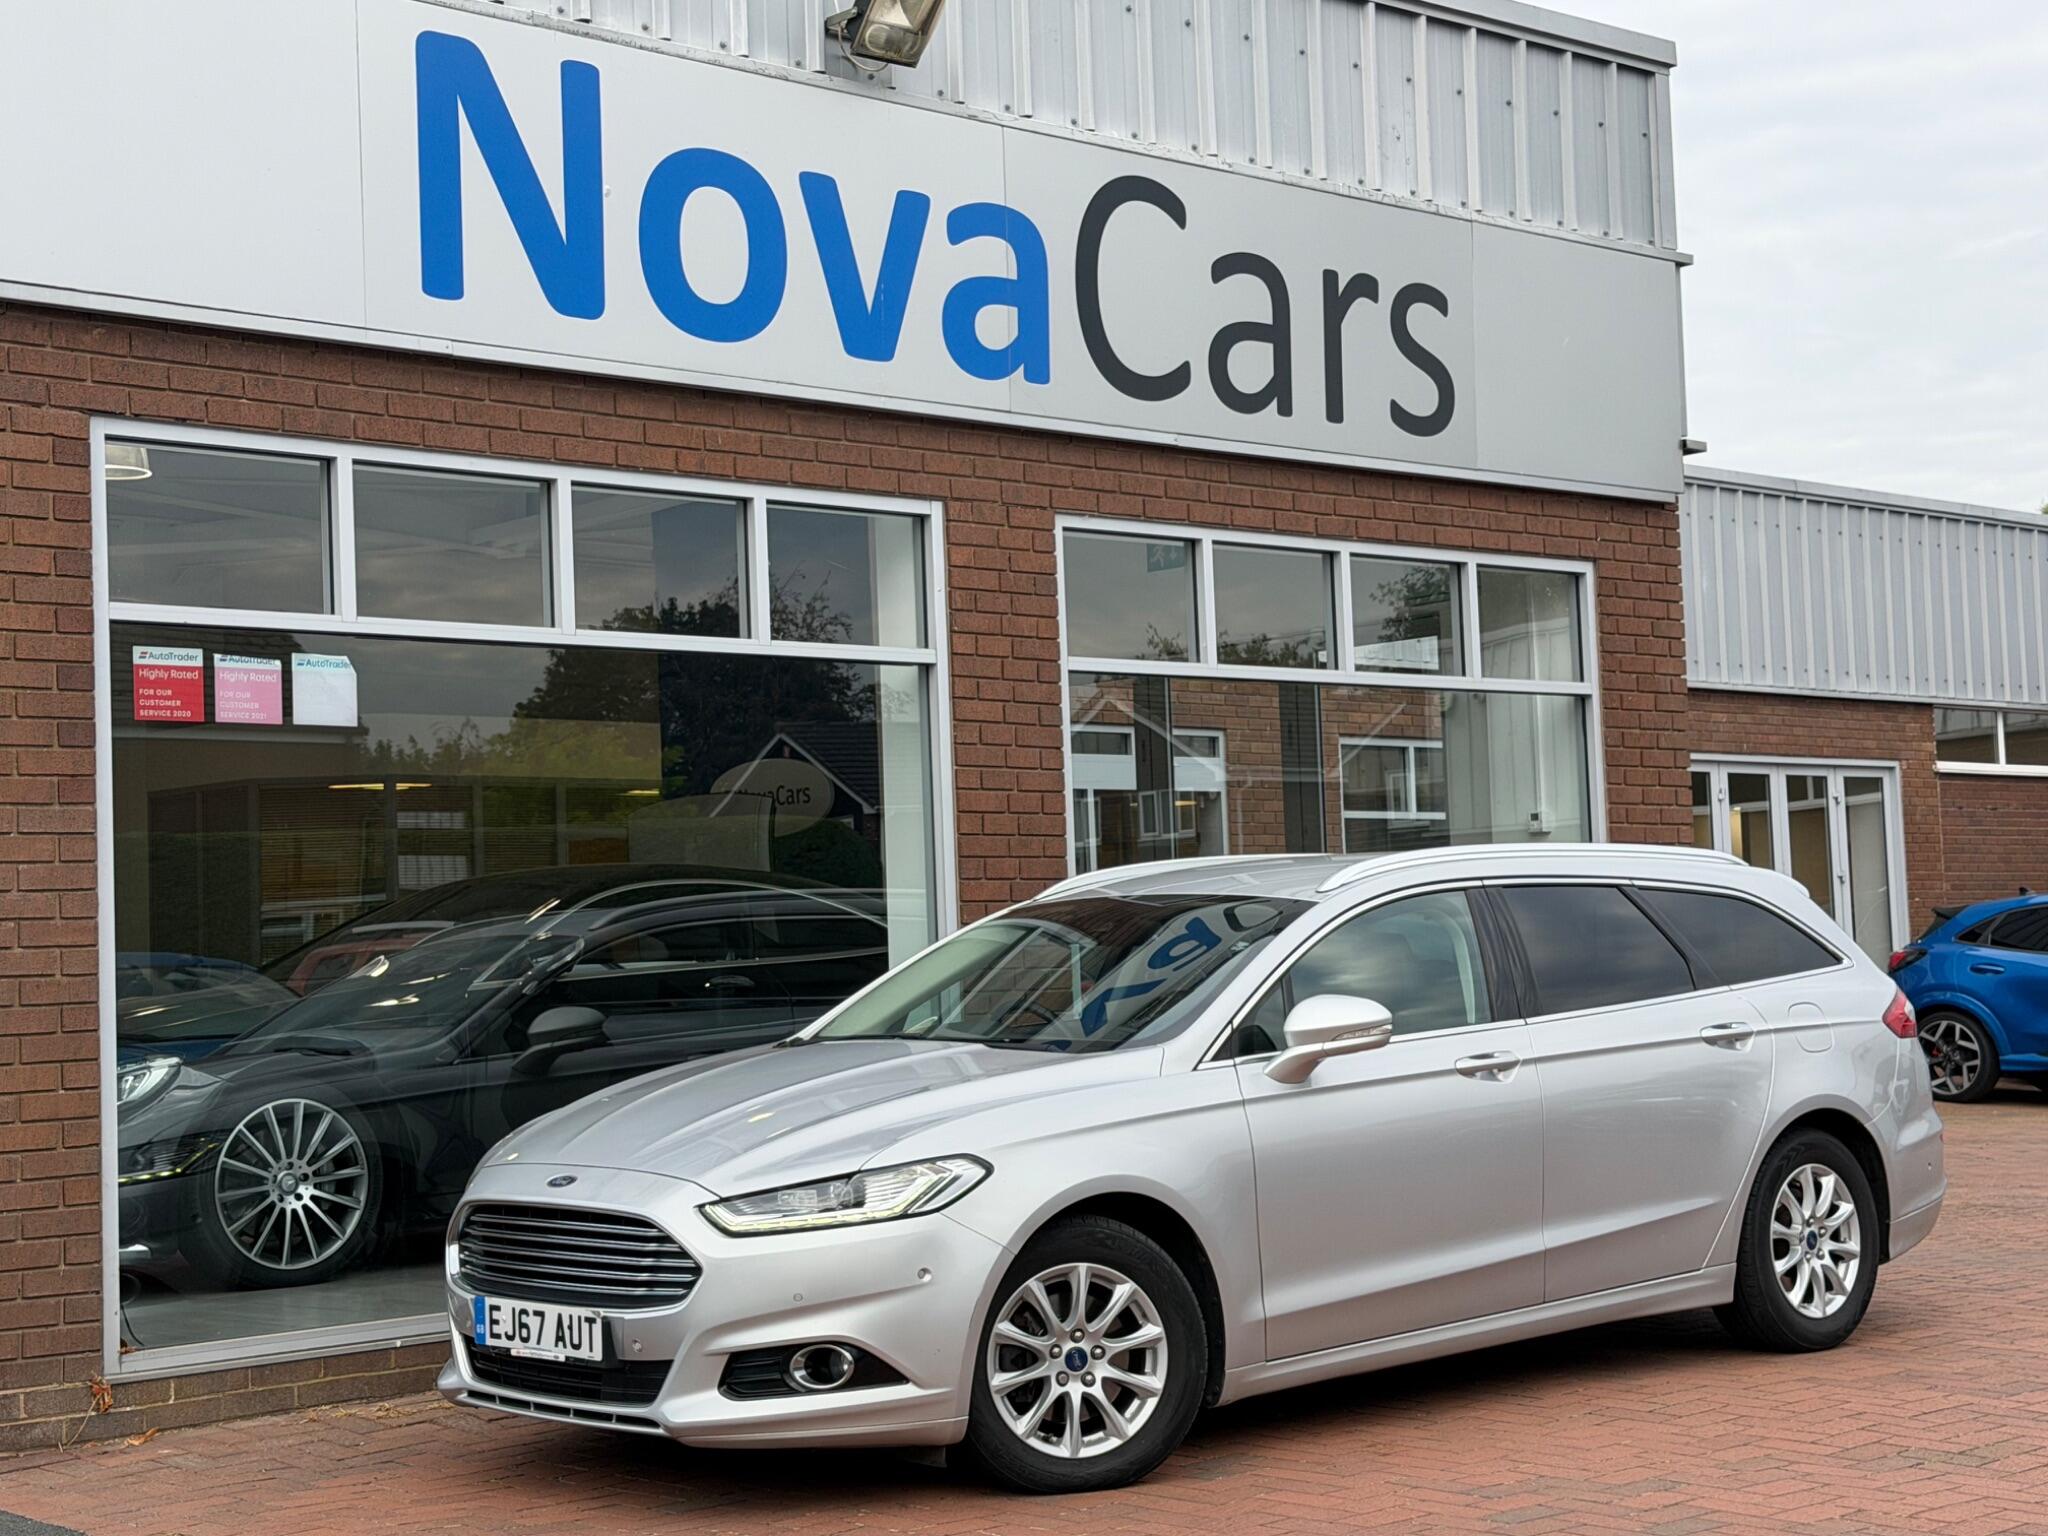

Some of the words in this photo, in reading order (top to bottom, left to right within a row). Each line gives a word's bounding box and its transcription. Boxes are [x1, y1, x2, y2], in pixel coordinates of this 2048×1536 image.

[416, 32, 1455, 437] NovaCars
[148, 651, 199, 662] AutoTrader
[305, 659, 351, 669] AutoTrade
[139, 668, 169, 680] Highly
[170, 669, 199, 680] Rated
[219, 671, 248, 683] Highly
[249, 672, 277, 683] Rated
[139, 688, 154, 696] FOR
[139, 699, 182, 707] CUSTOMER
[139, 709, 171, 717] SERVICE
[172, 710, 192, 718] 2020
[489, 1304, 546, 1346] EJ67
[554, 1312, 597, 1353] AUT
